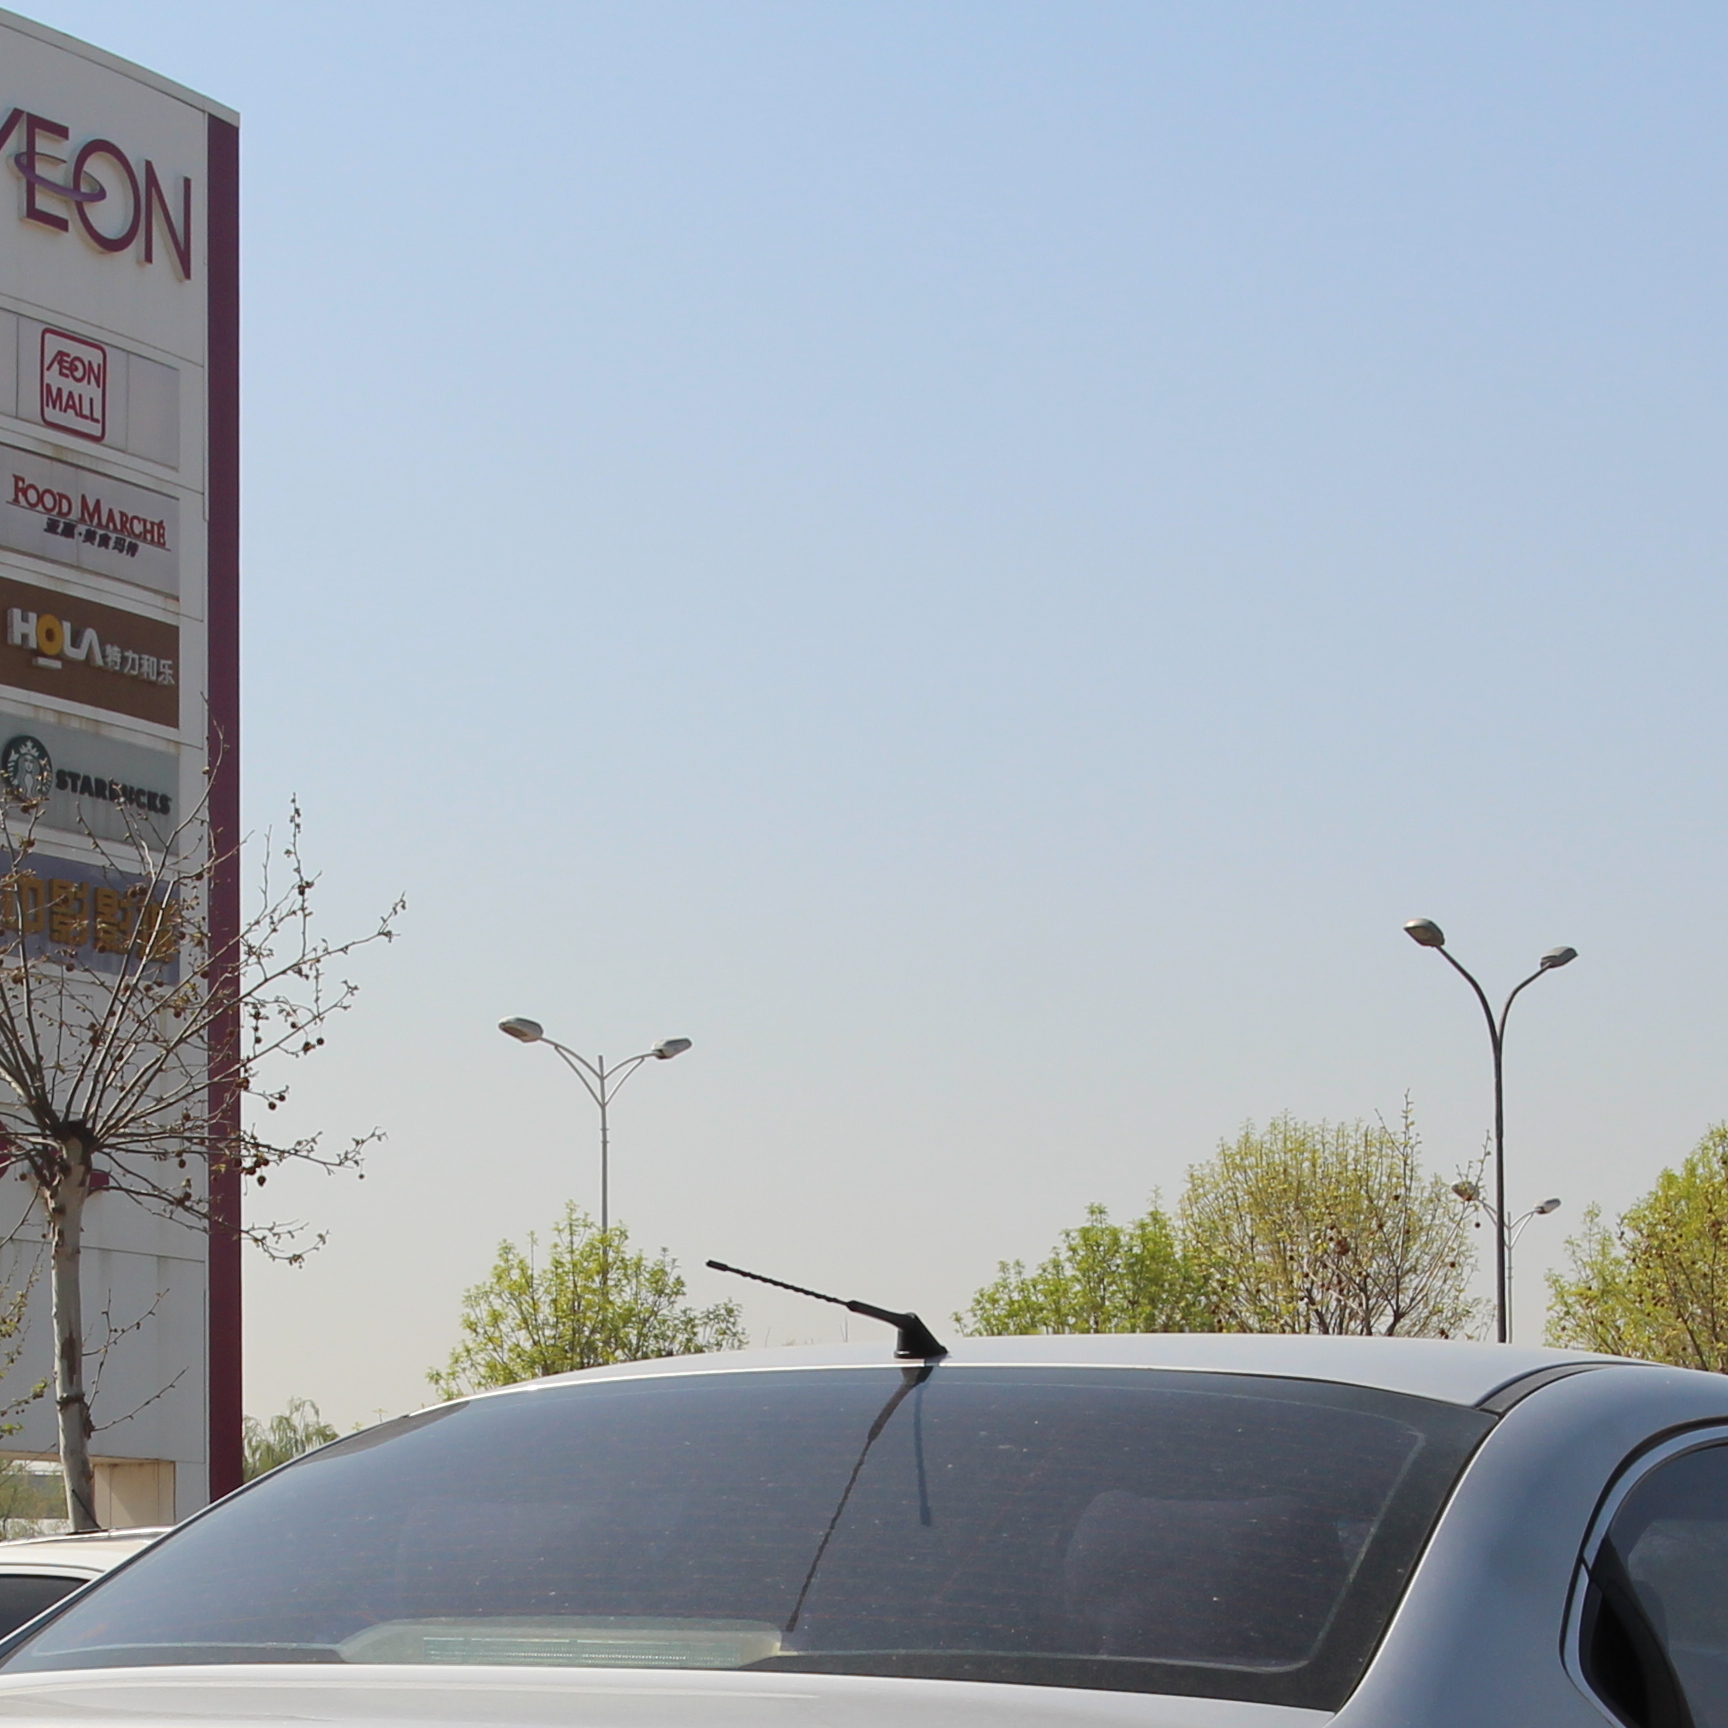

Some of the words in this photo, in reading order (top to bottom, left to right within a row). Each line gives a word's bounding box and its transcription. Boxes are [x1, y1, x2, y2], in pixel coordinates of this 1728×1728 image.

[45, 383, 101, 424] MALL
[7, 607, 104, 667] HOLA
[105, 644, 175, 686] 特力和乐
